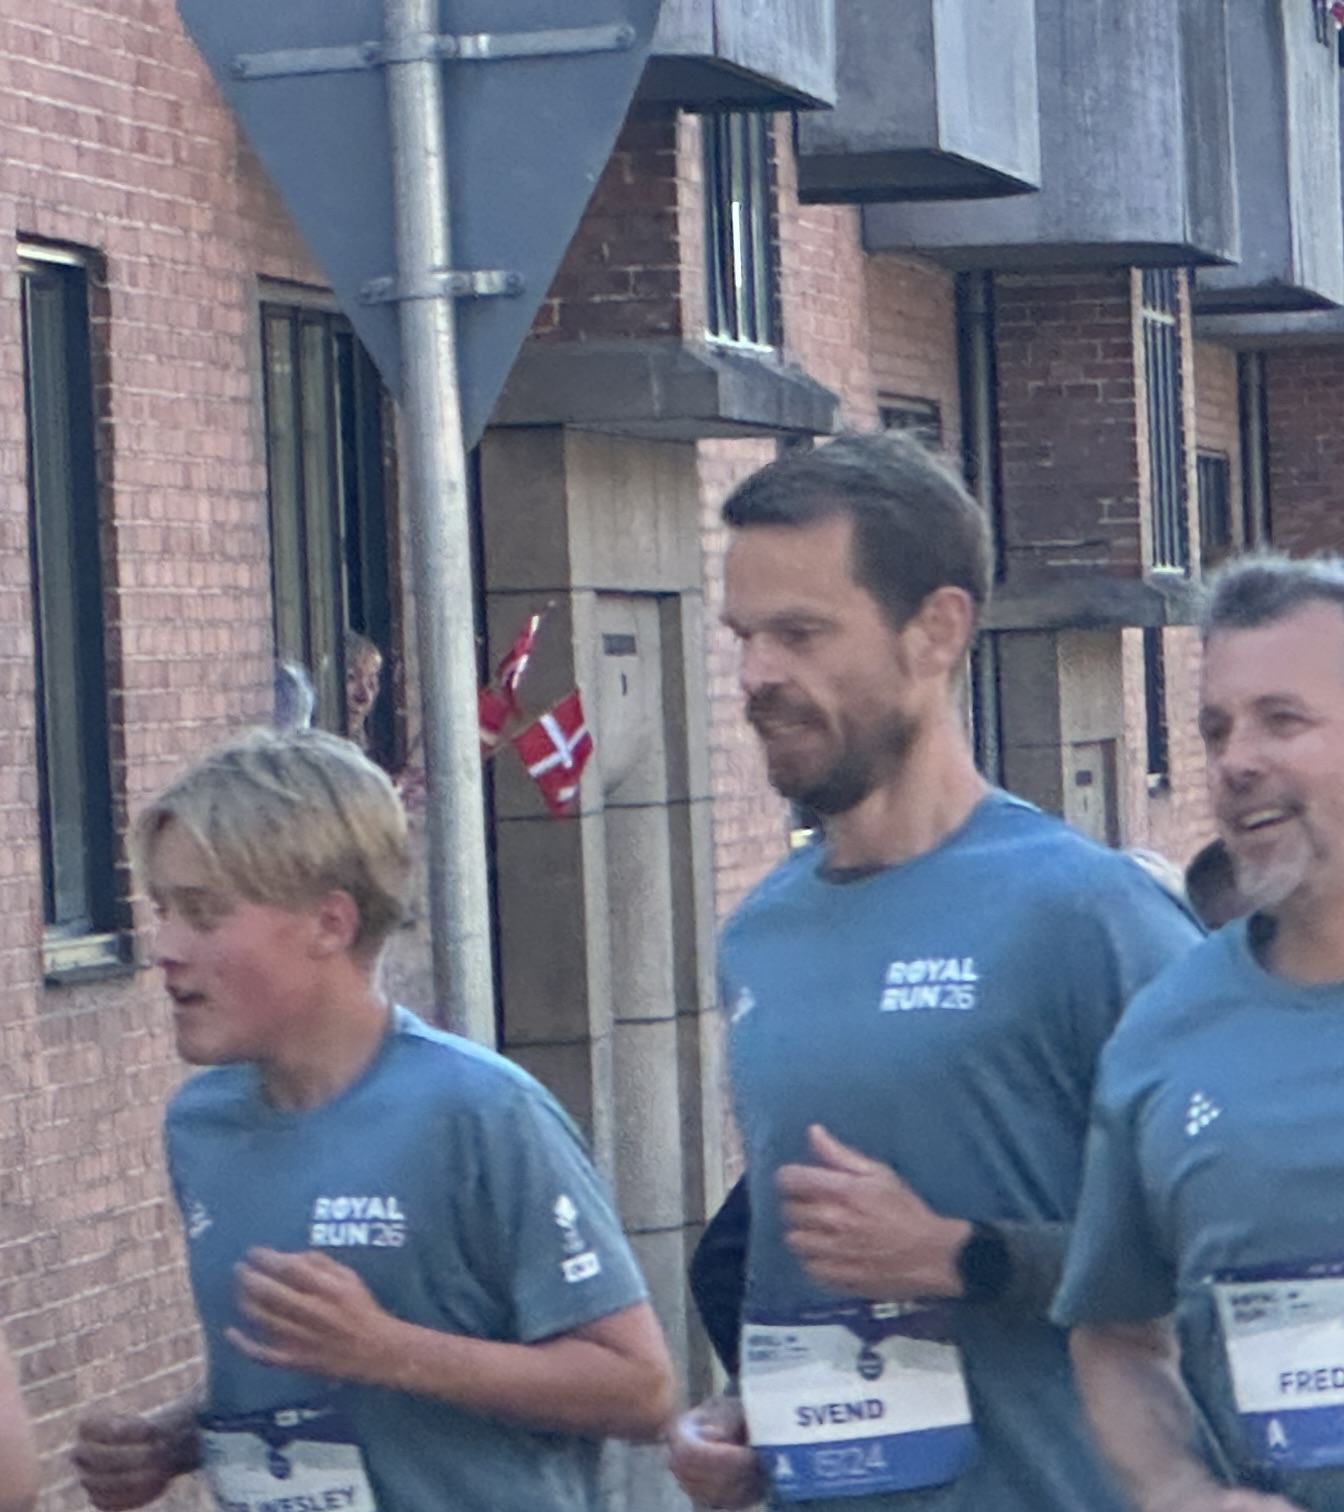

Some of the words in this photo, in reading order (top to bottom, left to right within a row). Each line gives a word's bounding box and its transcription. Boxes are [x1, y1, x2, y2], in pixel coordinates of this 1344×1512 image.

[887, 957, 978, 984] ROYAL
[314, 1196, 404, 1220] ROYAL
[795, 1399, 885, 1427] SVEND
[1267, 1418, 1288, 1448] A
